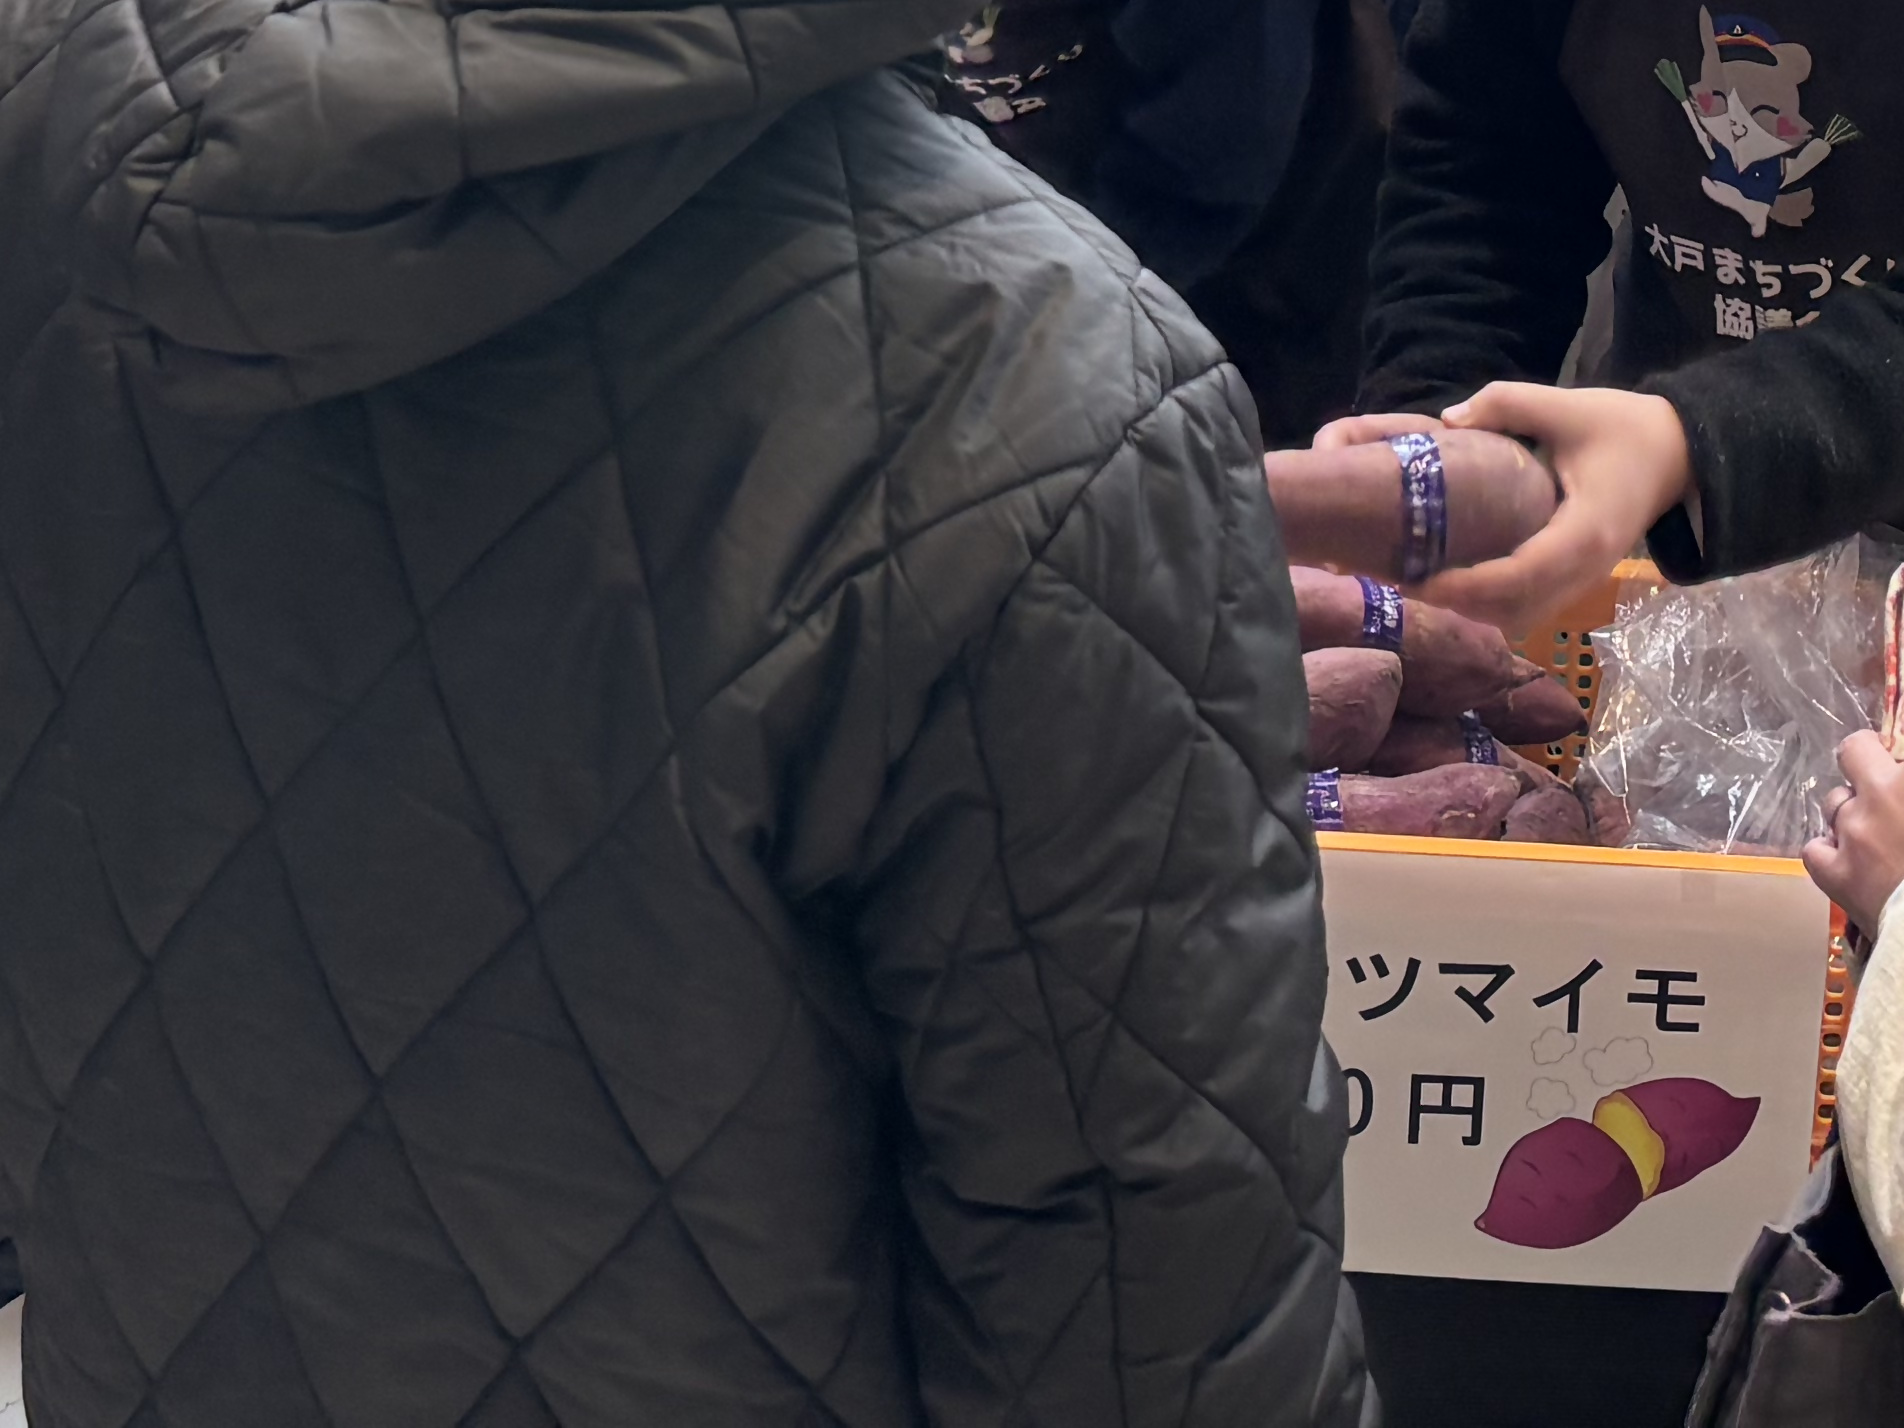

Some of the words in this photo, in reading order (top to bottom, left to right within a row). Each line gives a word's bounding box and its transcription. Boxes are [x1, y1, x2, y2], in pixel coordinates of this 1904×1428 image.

[1645, 223, 1896, 299] 大戸まちづく
[1345, 953, 1705, 1034] ツマイモ
